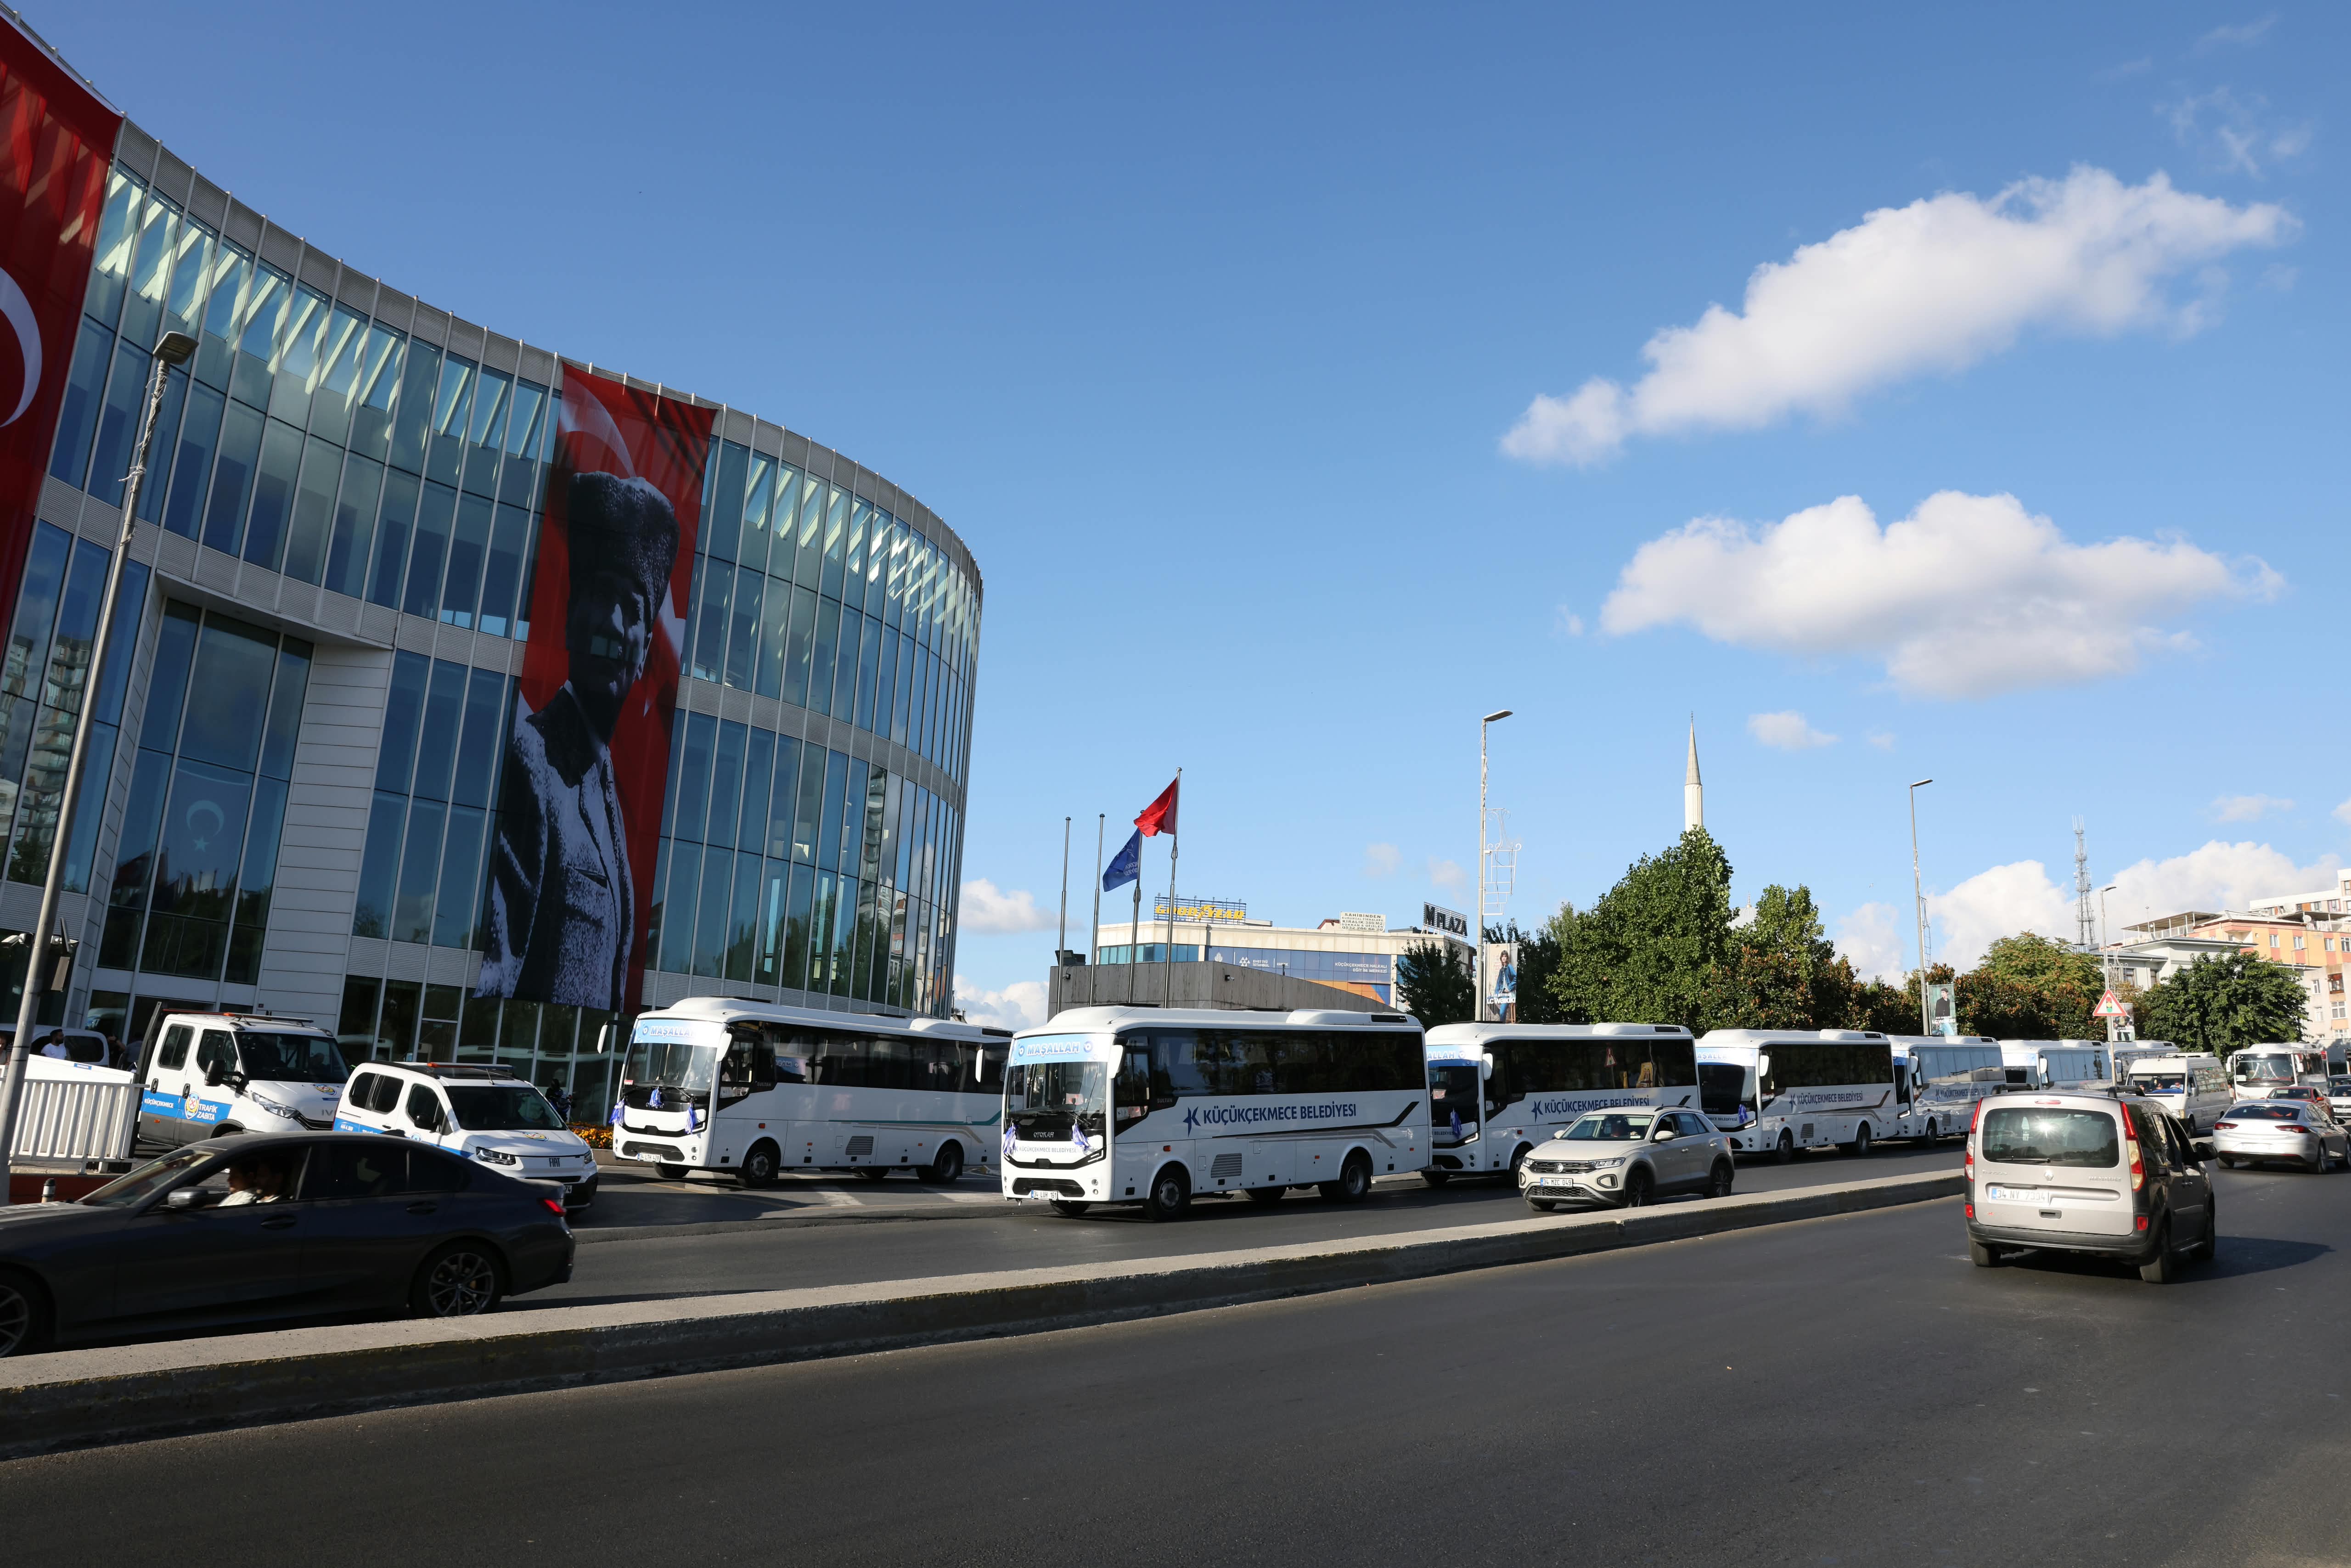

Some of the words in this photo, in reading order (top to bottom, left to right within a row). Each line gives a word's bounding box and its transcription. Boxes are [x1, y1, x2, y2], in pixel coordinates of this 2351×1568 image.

[1155, 905, 1244, 920] GOODYEAR
[1424, 904, 1435, 926] M
[1437, 912, 1468, 936] PLAZA
[1027, 1041, 1080, 1057] MAŞALLAH
[144, 1098, 174, 1108] KÜÇÜKÇEKMECE
[1545, 1098, 1608, 1115] KÜÇÜKÇEKMECE
[1610, 1095, 1649, 1107] BELEDİYESİ
[1797, 1093, 1837, 1105] KÜÇÜKÇEKMECE
[1838, 1090, 1863, 1102] BELEDİYESİ
[199, 1104, 218, 1113] TRAFİK
[1204, 1105, 1297, 1125] KÜÇÜKÇEKMECE
[549, 1158, 561, 1167] FIAT
[1997, 1190, 2006, 1198] 34
[2010, 1190, 2019, 1199] NY
